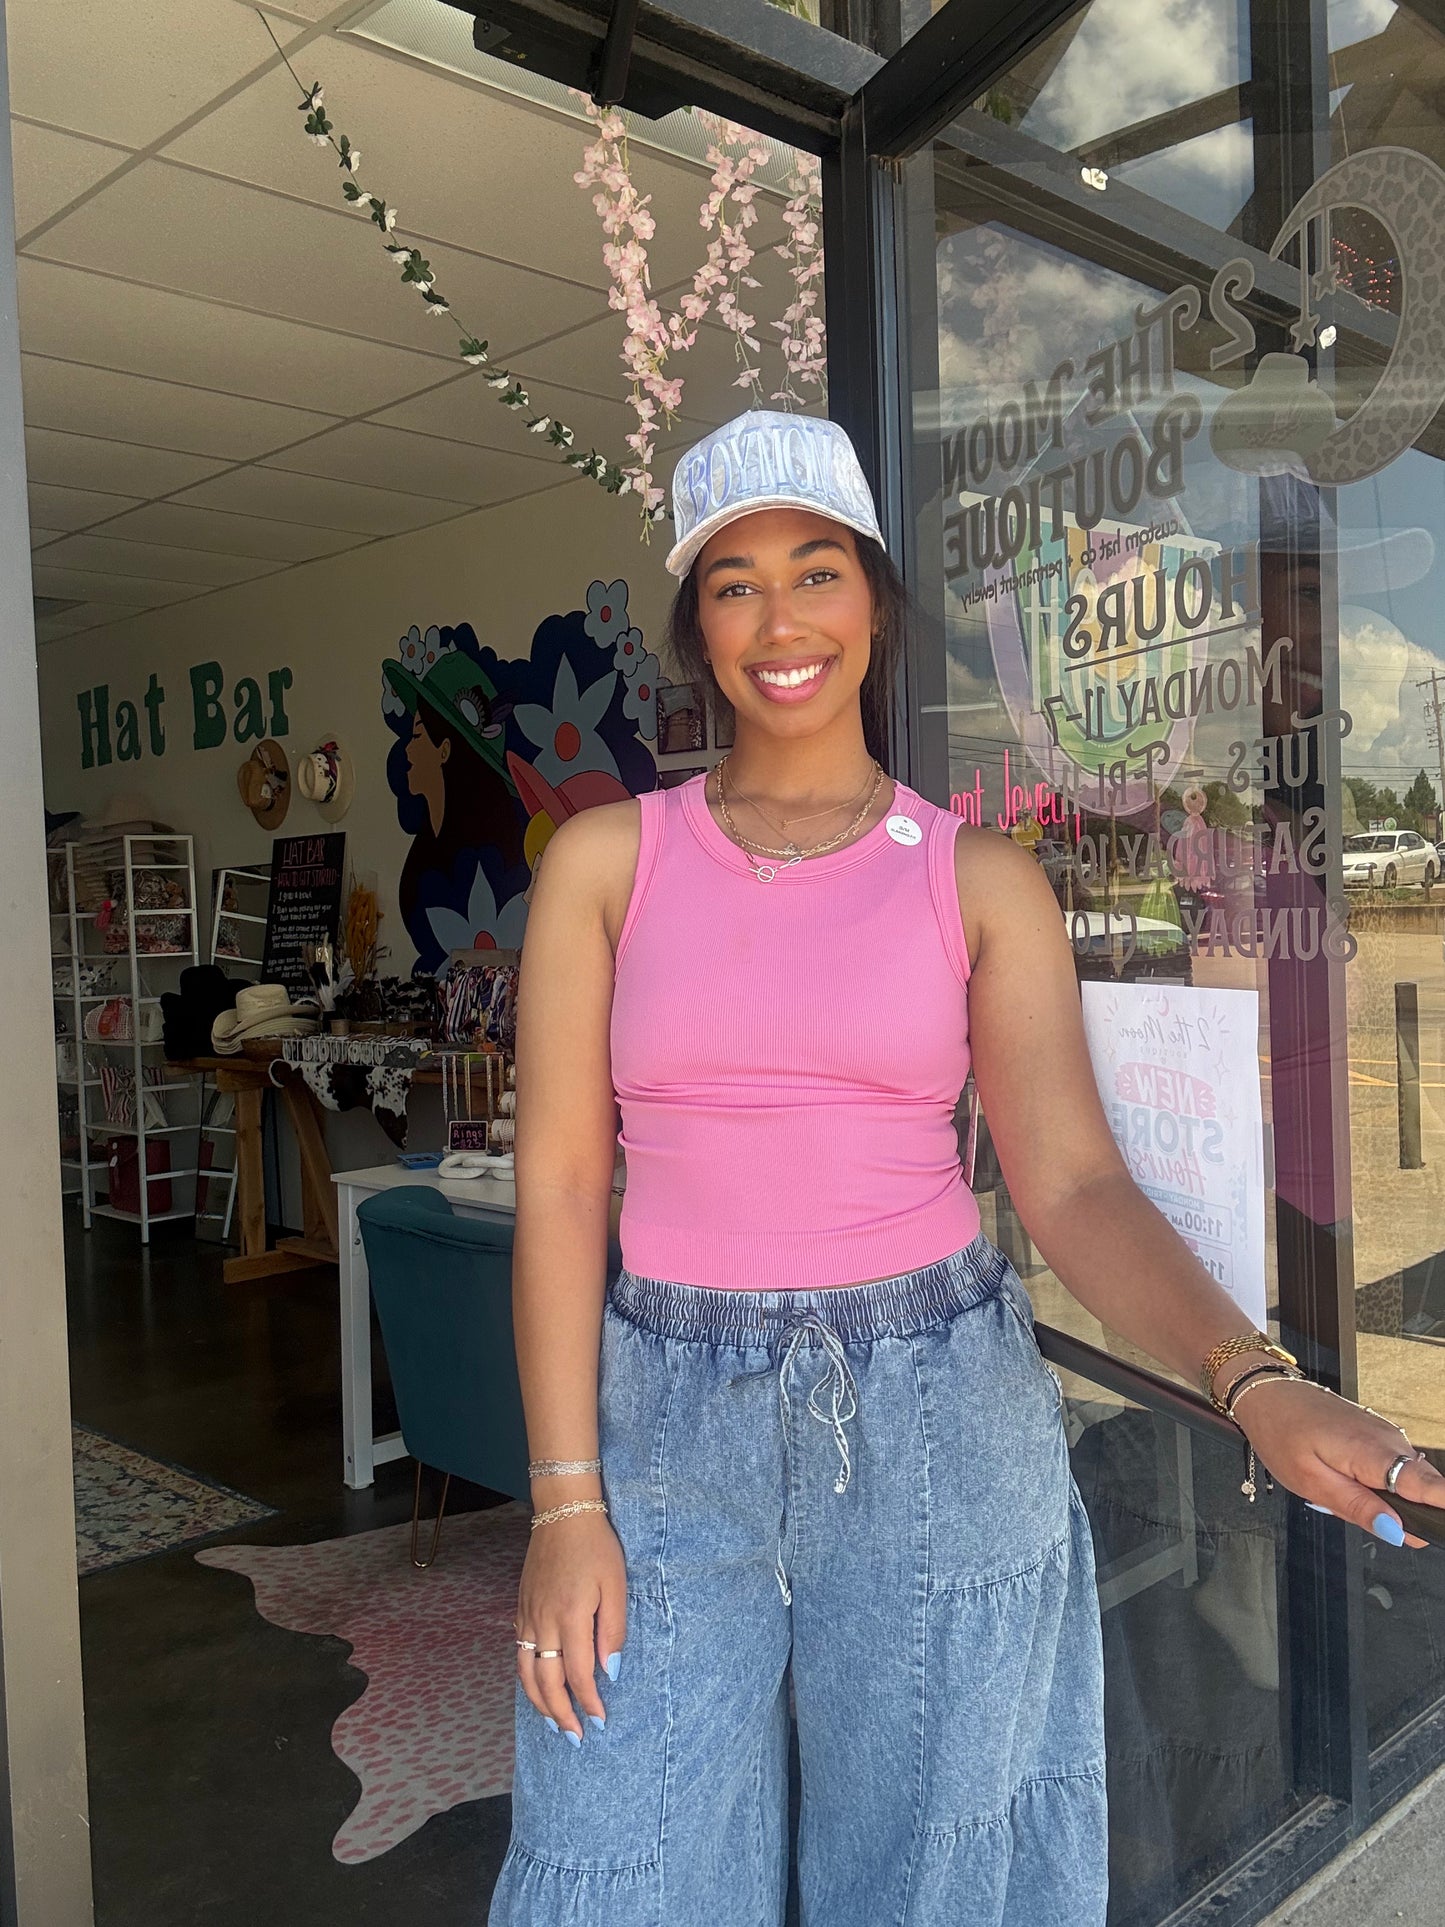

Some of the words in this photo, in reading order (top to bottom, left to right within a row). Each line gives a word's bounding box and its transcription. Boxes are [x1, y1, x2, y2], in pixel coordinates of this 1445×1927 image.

[76, 672, 166, 770] Hat
[189, 660, 294, 752] Bar
[283, 840, 305, 866] HAT
[306, 837, 326, 864] BAR
[453, 1129, 483, 1142] Rings
